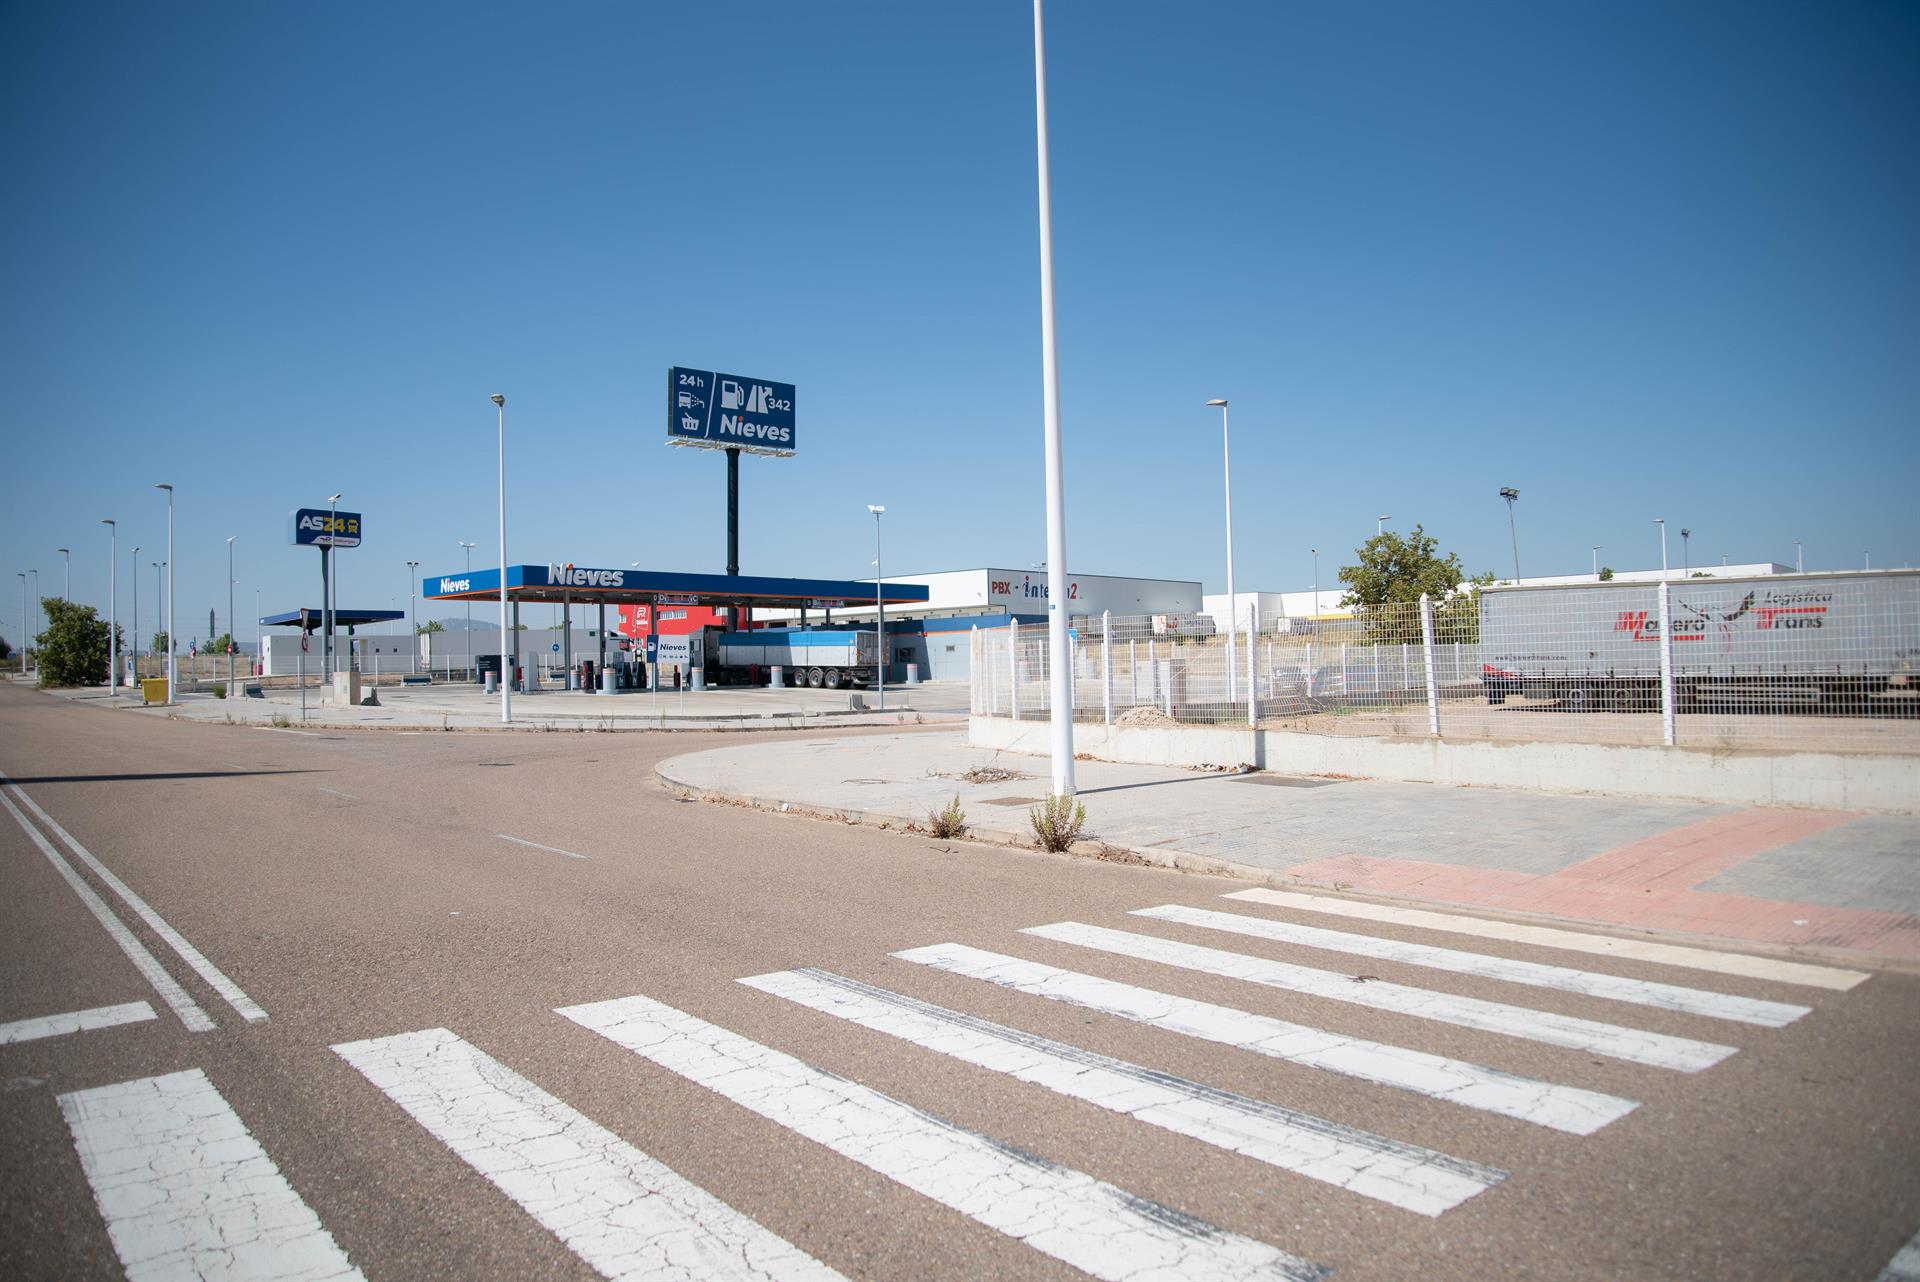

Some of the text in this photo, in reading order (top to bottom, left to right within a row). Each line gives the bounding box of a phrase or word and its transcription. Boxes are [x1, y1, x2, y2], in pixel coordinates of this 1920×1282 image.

[768, 397, 791, 412] 342
[720, 413, 791, 442] Nieves
[299, 515, 346, 533] AS24
[547, 562, 625, 587] Nieves
[440, 576, 470, 594] Nieves
[992, 580, 1011, 595] PBX
[1615, 607, 1828, 636] Maero Trans
[659, 642, 688, 652] Nieves
